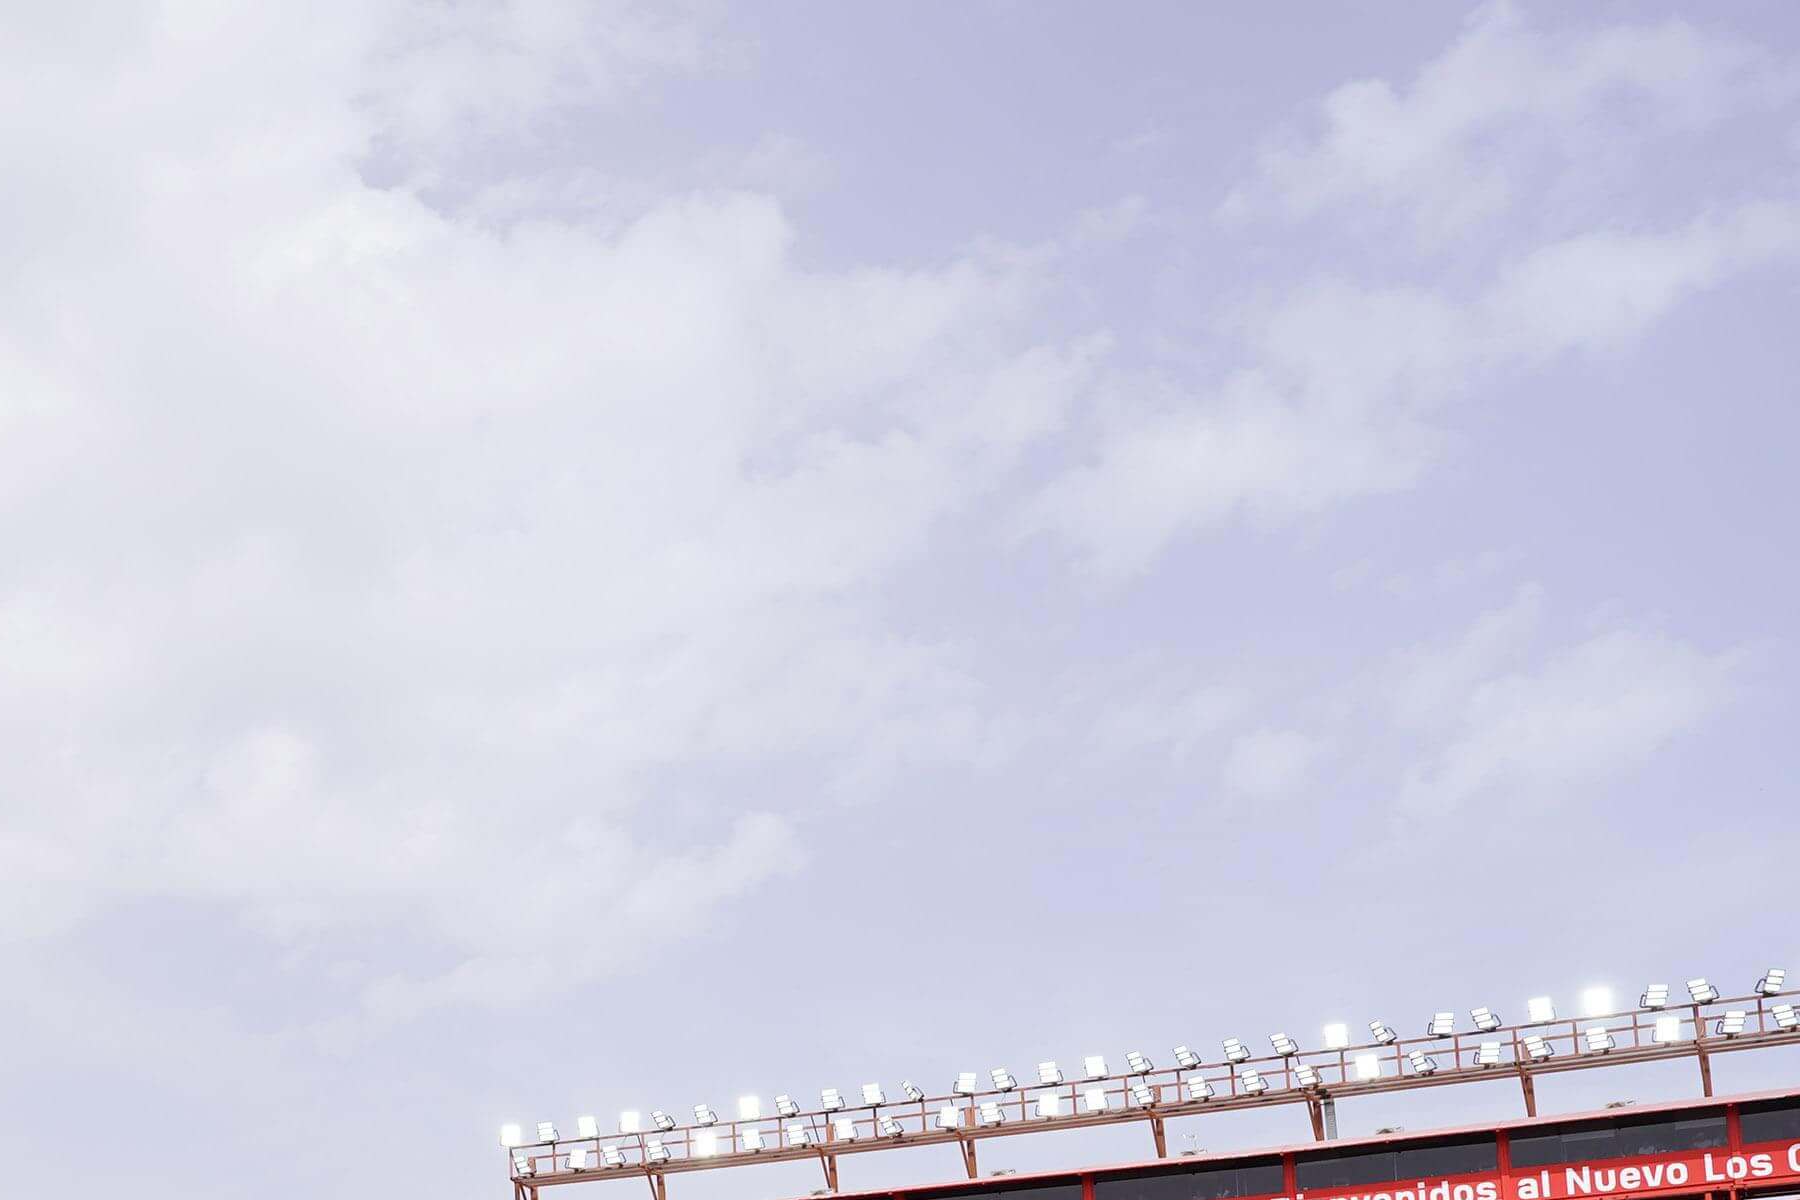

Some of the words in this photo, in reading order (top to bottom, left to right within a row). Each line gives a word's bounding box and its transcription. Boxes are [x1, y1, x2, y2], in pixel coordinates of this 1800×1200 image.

[1518, 1169, 1550, 1200] al
[1566, 1159, 1689, 1196] Nuevo
[1704, 1150, 1773, 1182] Los
